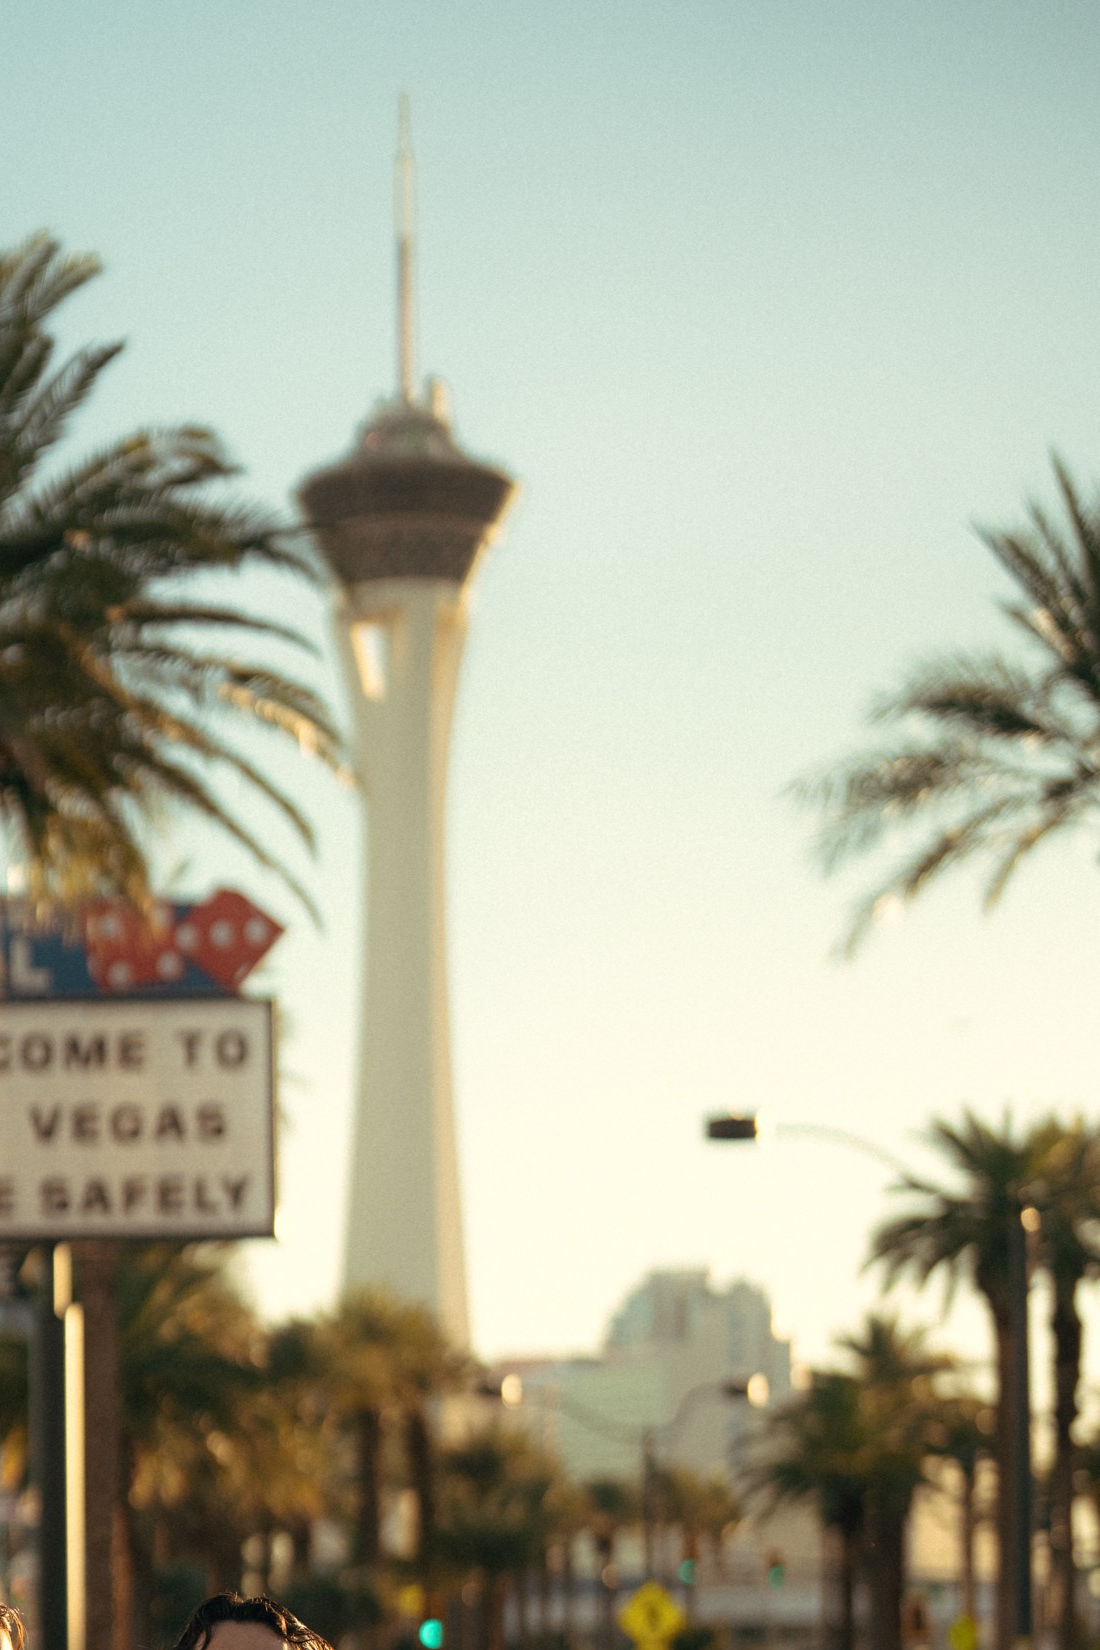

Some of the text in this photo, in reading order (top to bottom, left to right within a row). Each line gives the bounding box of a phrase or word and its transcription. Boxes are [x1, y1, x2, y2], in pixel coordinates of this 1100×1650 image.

[174, 1028, 248, 1073] TO
[29, 1104, 224, 1143] VEGAS
[41, 1176, 250, 1217] SAFELY
